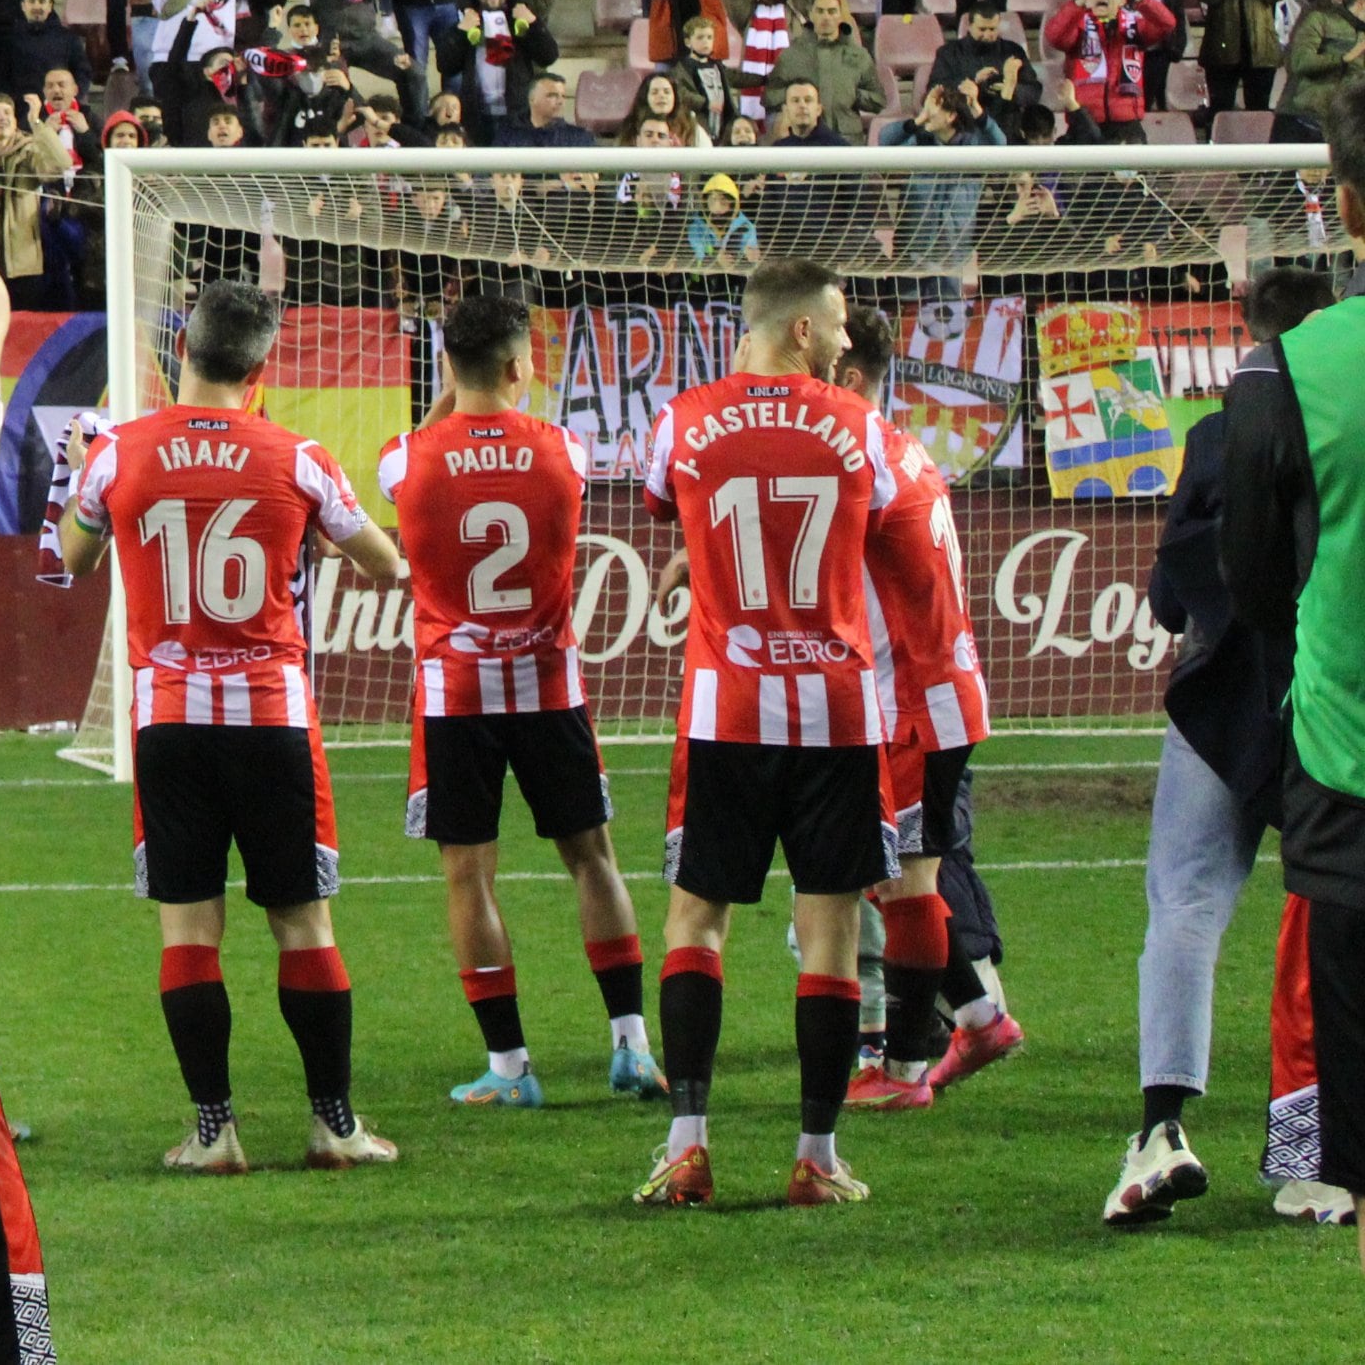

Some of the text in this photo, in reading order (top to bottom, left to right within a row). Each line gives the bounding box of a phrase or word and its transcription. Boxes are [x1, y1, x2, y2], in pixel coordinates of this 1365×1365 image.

[746, 386, 790, 397] LINLAB
[187, 419, 230, 431] LINLAB
[684, 402, 868, 473] CASTELLANO
[157, 437, 250, 473] IÑAKI
[444, 445, 534, 477] PAOLO
[674, 456, 701, 481] J.
[459, 501, 533, 615] 2
[709, 476, 840, 611] 17
[138, 498, 267, 625] 16
[195, 645, 271, 670] EBRO
[769, 639, 850, 665] EBRO
